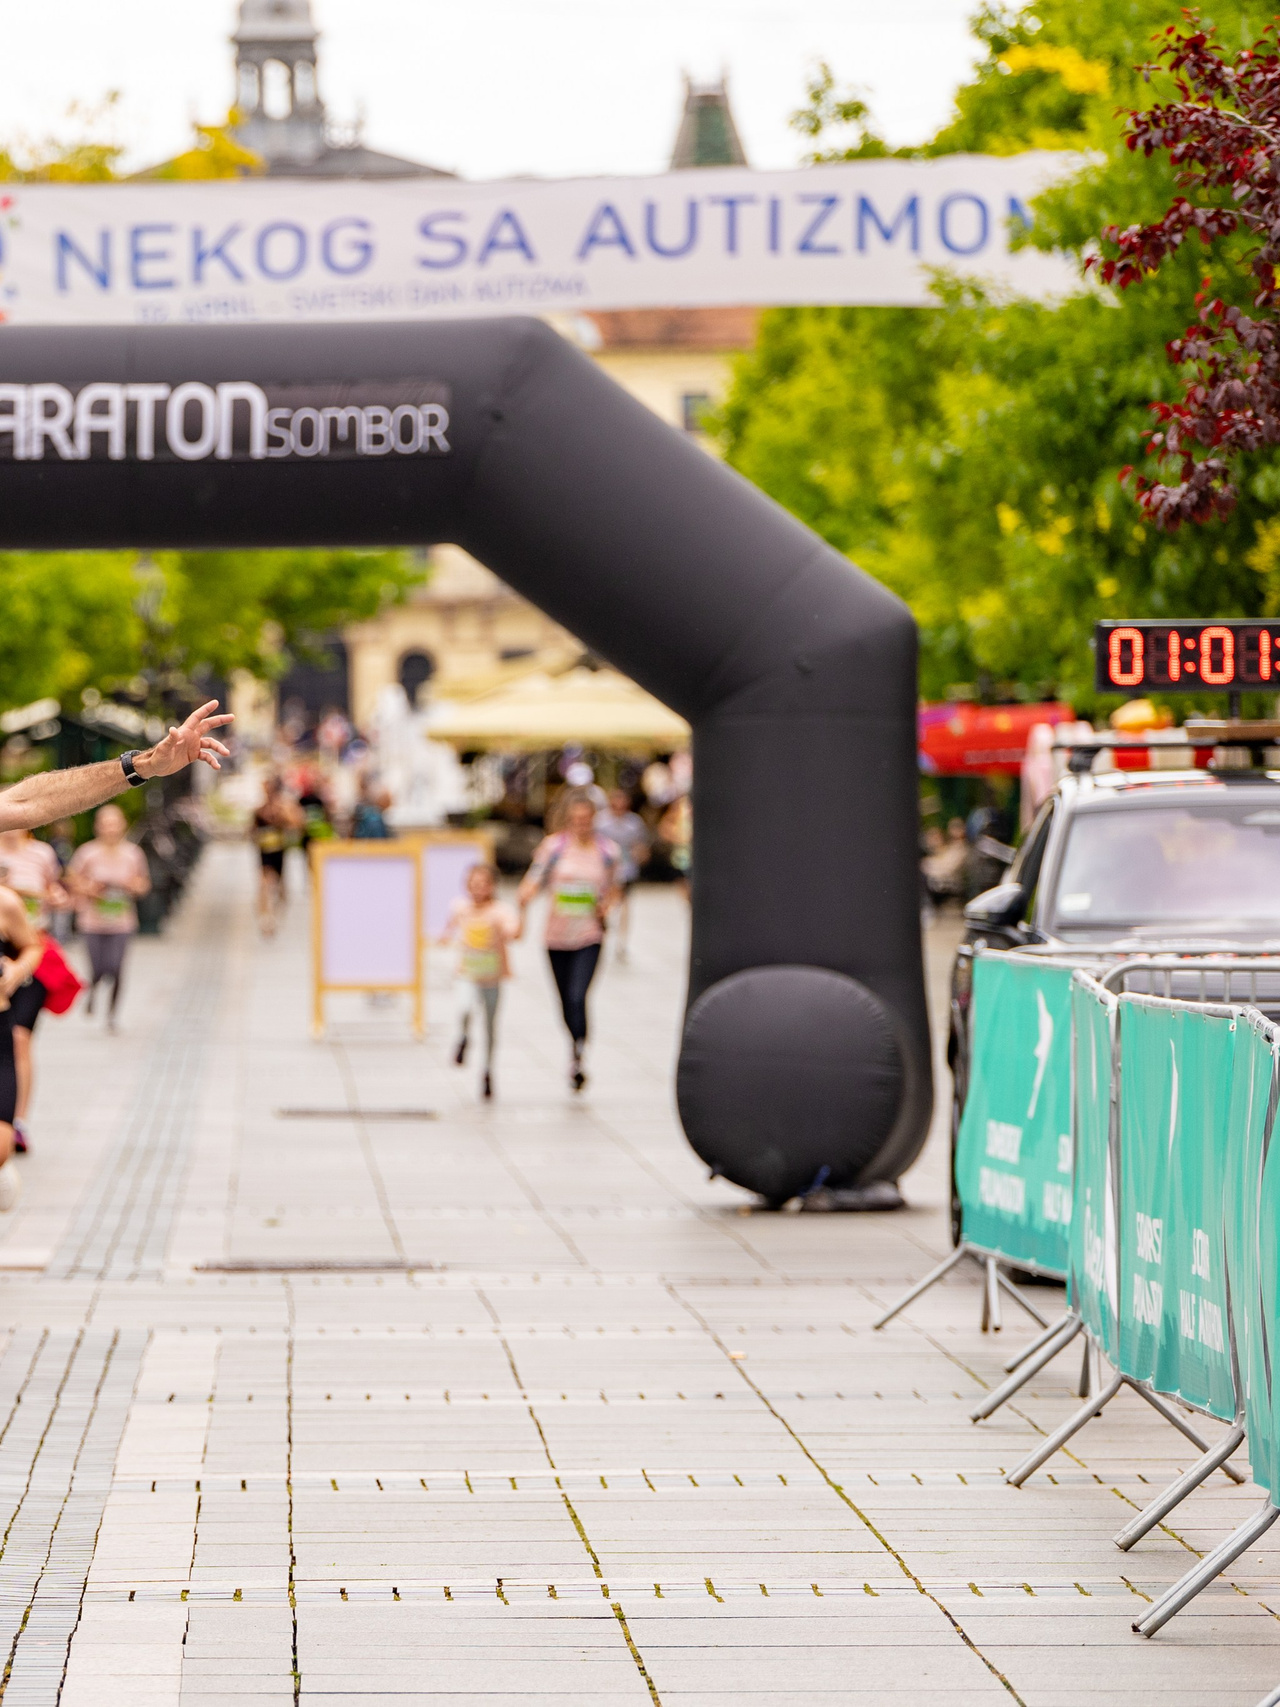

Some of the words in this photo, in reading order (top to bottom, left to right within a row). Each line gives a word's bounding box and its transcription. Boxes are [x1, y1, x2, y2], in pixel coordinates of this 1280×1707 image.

[55, 217, 375, 293] NEKOG
[418, 208, 538, 270] SA
[266, 403, 451, 459] SOMBOR
